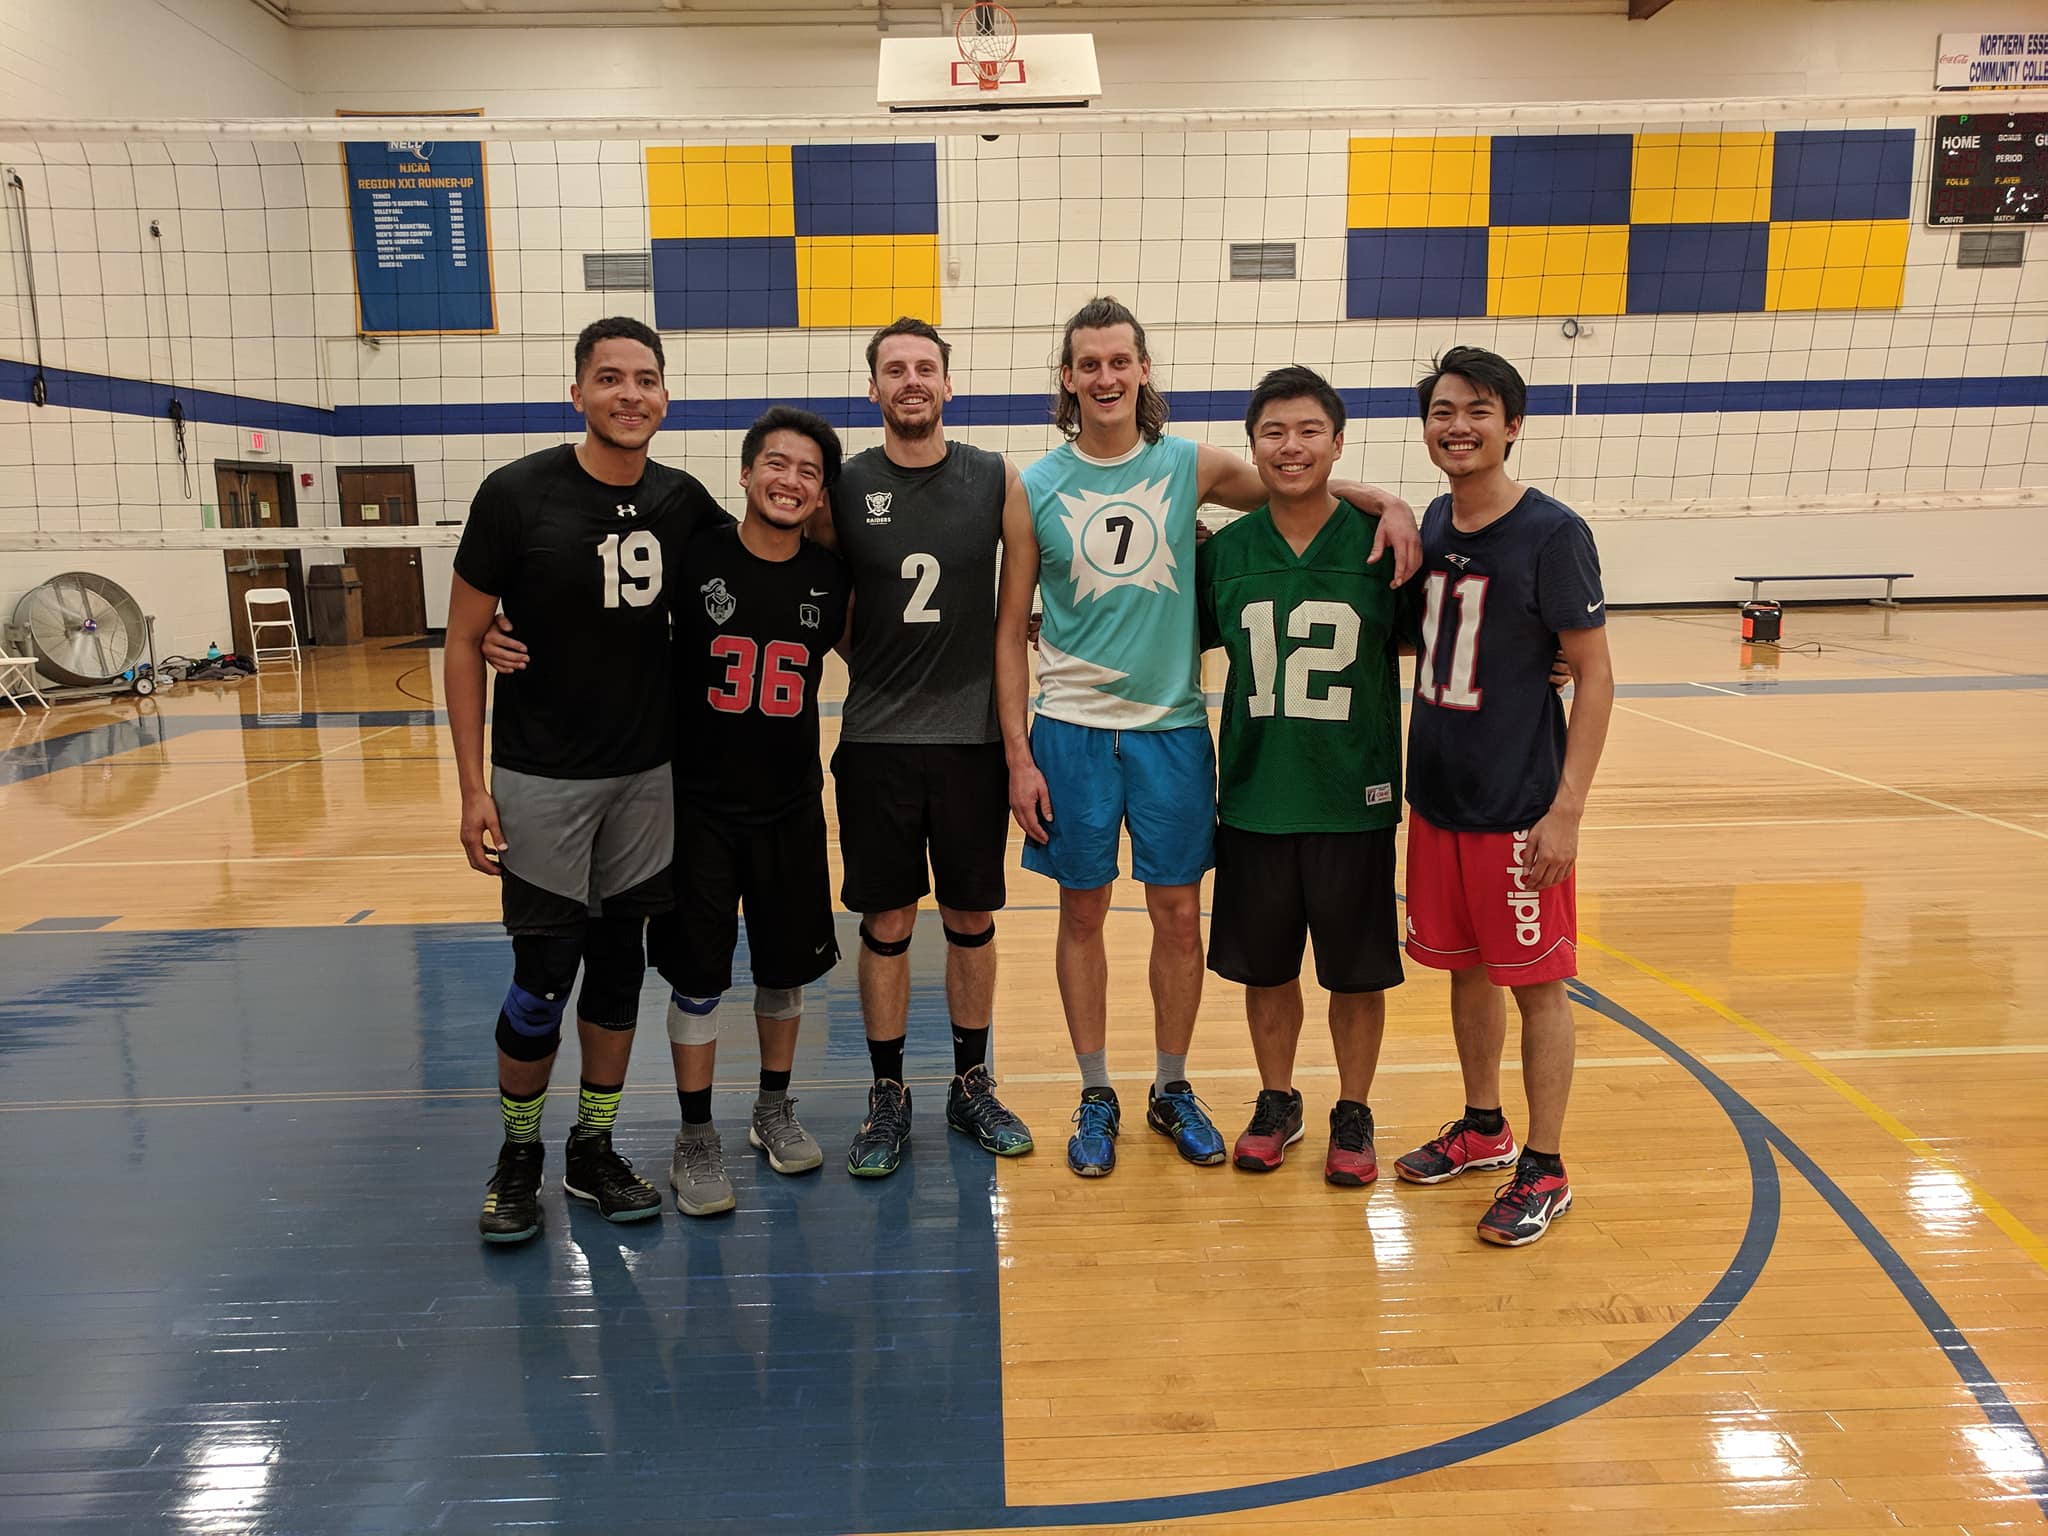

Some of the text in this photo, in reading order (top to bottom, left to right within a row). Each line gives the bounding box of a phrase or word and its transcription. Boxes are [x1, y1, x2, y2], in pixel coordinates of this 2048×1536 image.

[1979, 35, 2025, 55] NORTHERN
[1969, 60, 2048, 82] COMMUNITY COLLE
[1942, 135, 1981, 149] HOME
[400, 163, 431, 173] NJCAA
[1995, 154, 2023, 163] PERIOD
[358, 177, 474, 189] REGION XXI RUNNER-UP
[1939, 215, 1964, 224] POINTS
[1105, 515, 1134, 566] 7
[597, 530, 663, 609] 19
[901, 553, 941, 623] 2
[1418, 570, 1489, 711] 11
[1240, 599, 1363, 721] 12
[707, 634, 810, 718] 36
